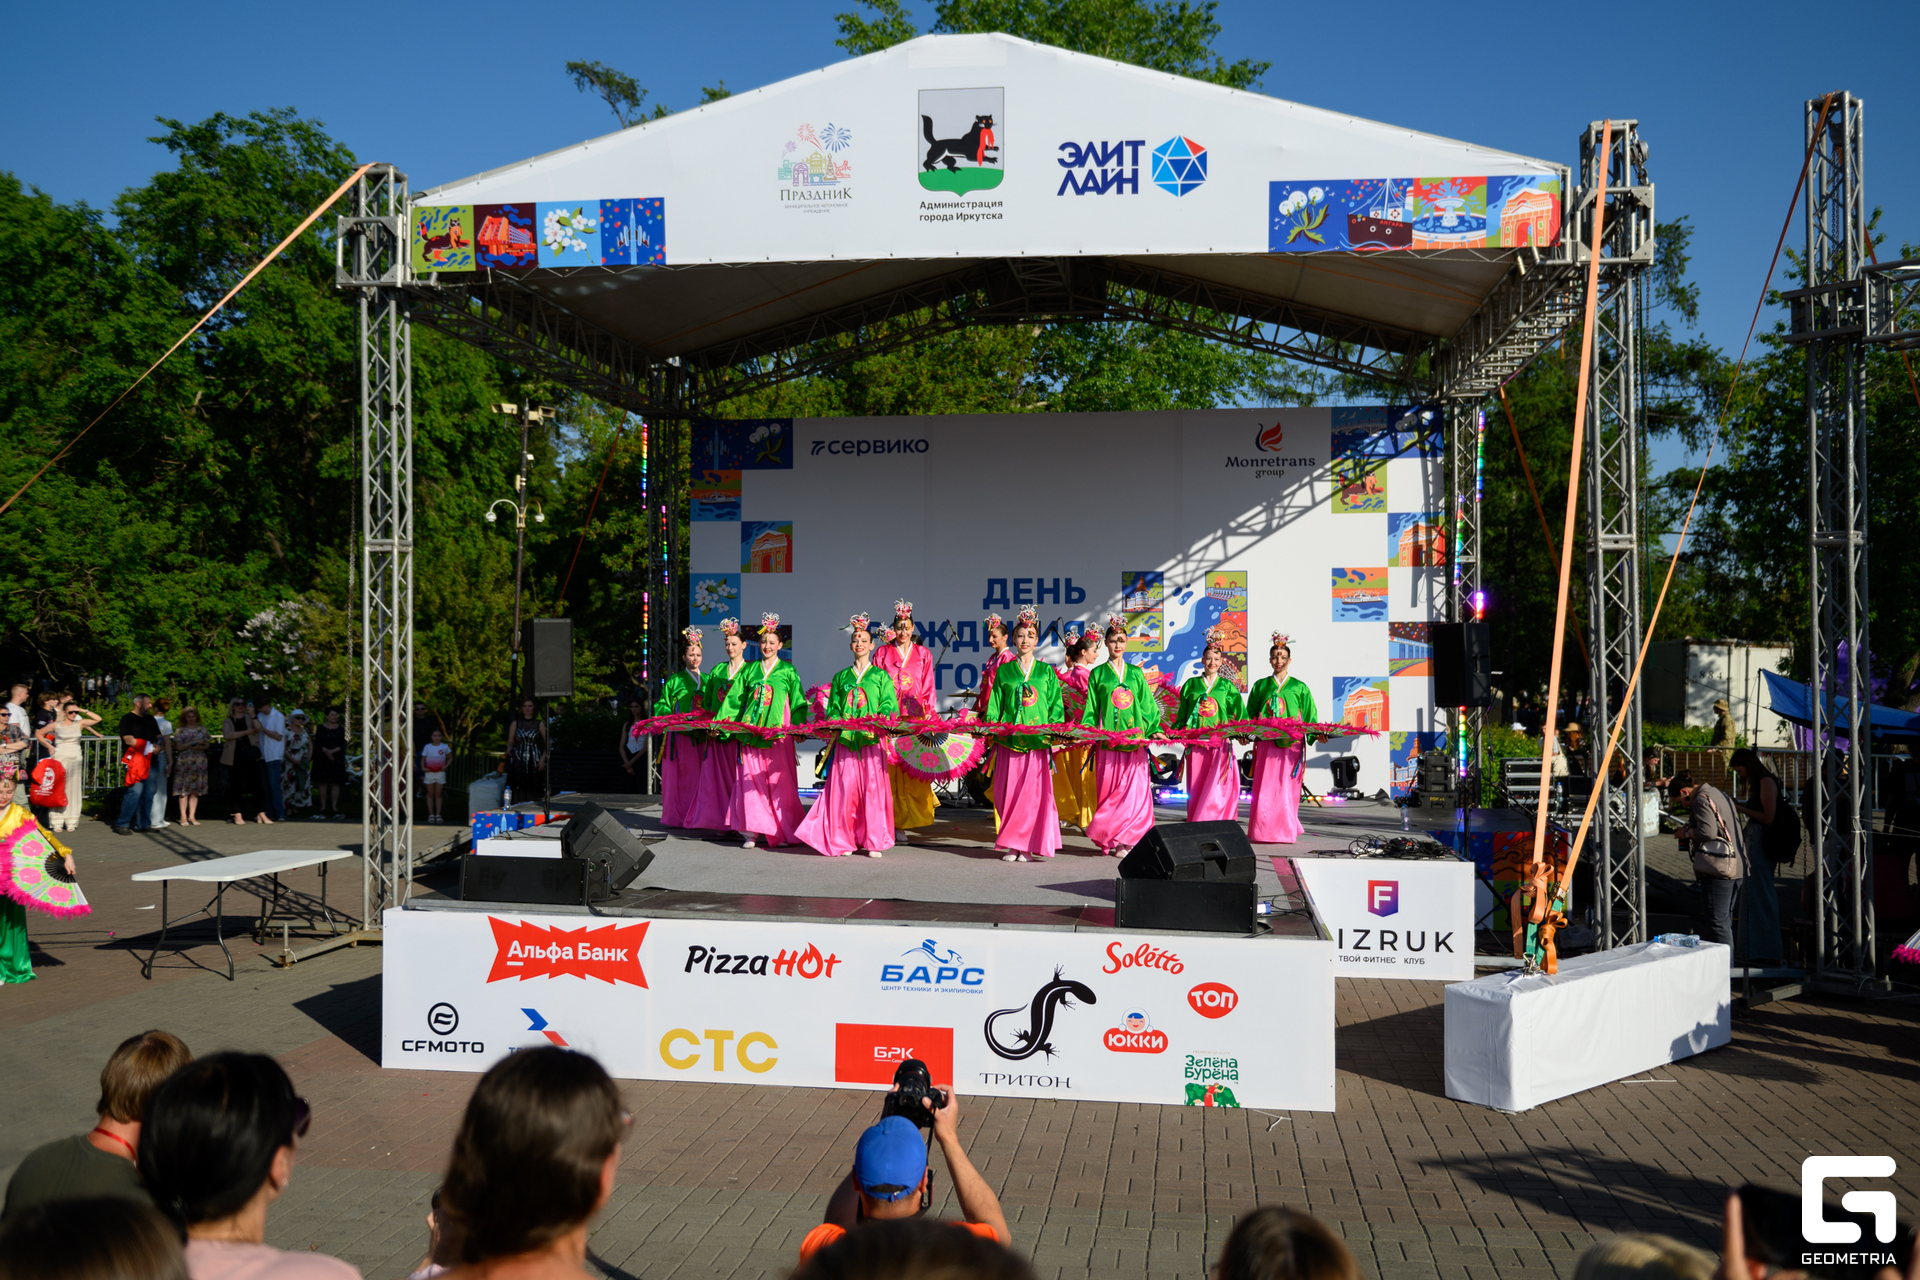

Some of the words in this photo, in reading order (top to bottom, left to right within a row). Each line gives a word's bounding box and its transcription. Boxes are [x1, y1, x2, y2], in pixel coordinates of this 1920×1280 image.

[1057, 140, 1146, 168] ЭЛИТ
[1057, 168, 1139, 196] ЛАЙН
[919, 201, 1003, 211] Администрация
[919, 214, 954, 223] города
[956, 212, 1003, 222] Иркутска
[1379, 219, 1404, 228] АНГАРА
[828, 439, 929, 456] сервико
[1225, 456, 1316, 468] Monretrans
[1255, 469, 1285, 479] group
[982, 578, 1086, 610] ДЕНЬ
[1338, 928, 1454, 953] IZRUK
[1338, 955, 1361, 963] ТВОЙ
[1362, 956, 1396, 964] ФИТНЕС
[1403, 957, 1426, 965] КЛУБ
[880, 964, 985, 985] БАРС
[1191, 990, 1235, 1009] ТОП
[402, 1040, 485, 1053] CFMOTO
[1108, 1033, 1163, 1049] ЮККИ
[659, 1028, 779, 1074] СТС
[874, 1046, 914, 1059] БРК
[1185, 1054, 1238, 1068] Зелёна
[979, 1072, 1072, 1089] ТРИТОН
[1184, 1066, 1239, 1083] Бурёна
